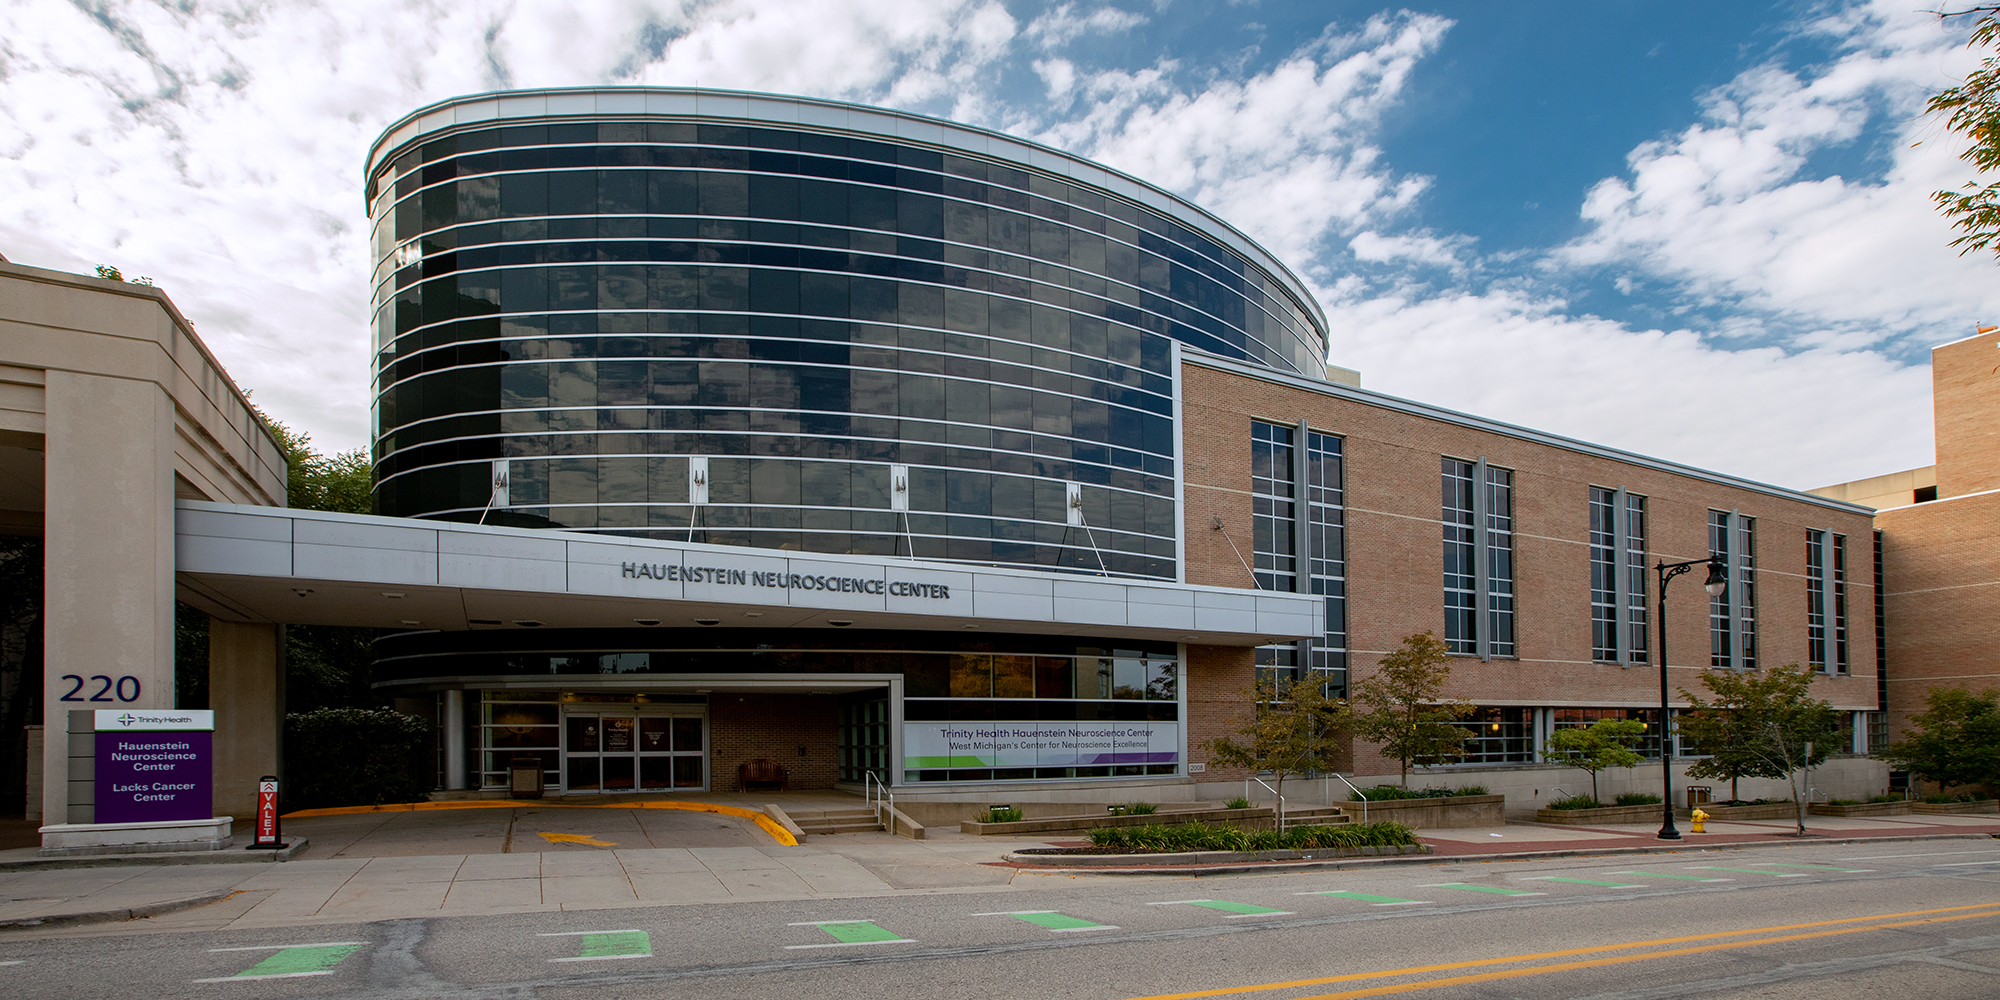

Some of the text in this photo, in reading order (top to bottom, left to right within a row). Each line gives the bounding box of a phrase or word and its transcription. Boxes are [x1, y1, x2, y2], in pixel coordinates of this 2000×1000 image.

[622, 561, 950, 599] HAUENSTEIN NEUROSCIENCE CENTER
[60, 674, 141, 702] 220
[137, 717, 163, 725] Trinity
[940, 728, 1153, 740] Trinity Health Hauenstein Neuroscience Center
[118, 741, 190, 750] Hauenstein
[949, 740, 1148, 751] West Michigan's Center for Neuroscience Excellence
[111, 752, 197, 761] Neuroscience
[133, 762, 176, 771] Center
[1190, 764, 1204, 772] 2008
[113, 782, 196, 792] Lacks Cancer
[133, 793, 176, 802] Center
[263, 793, 273, 836] VALET
